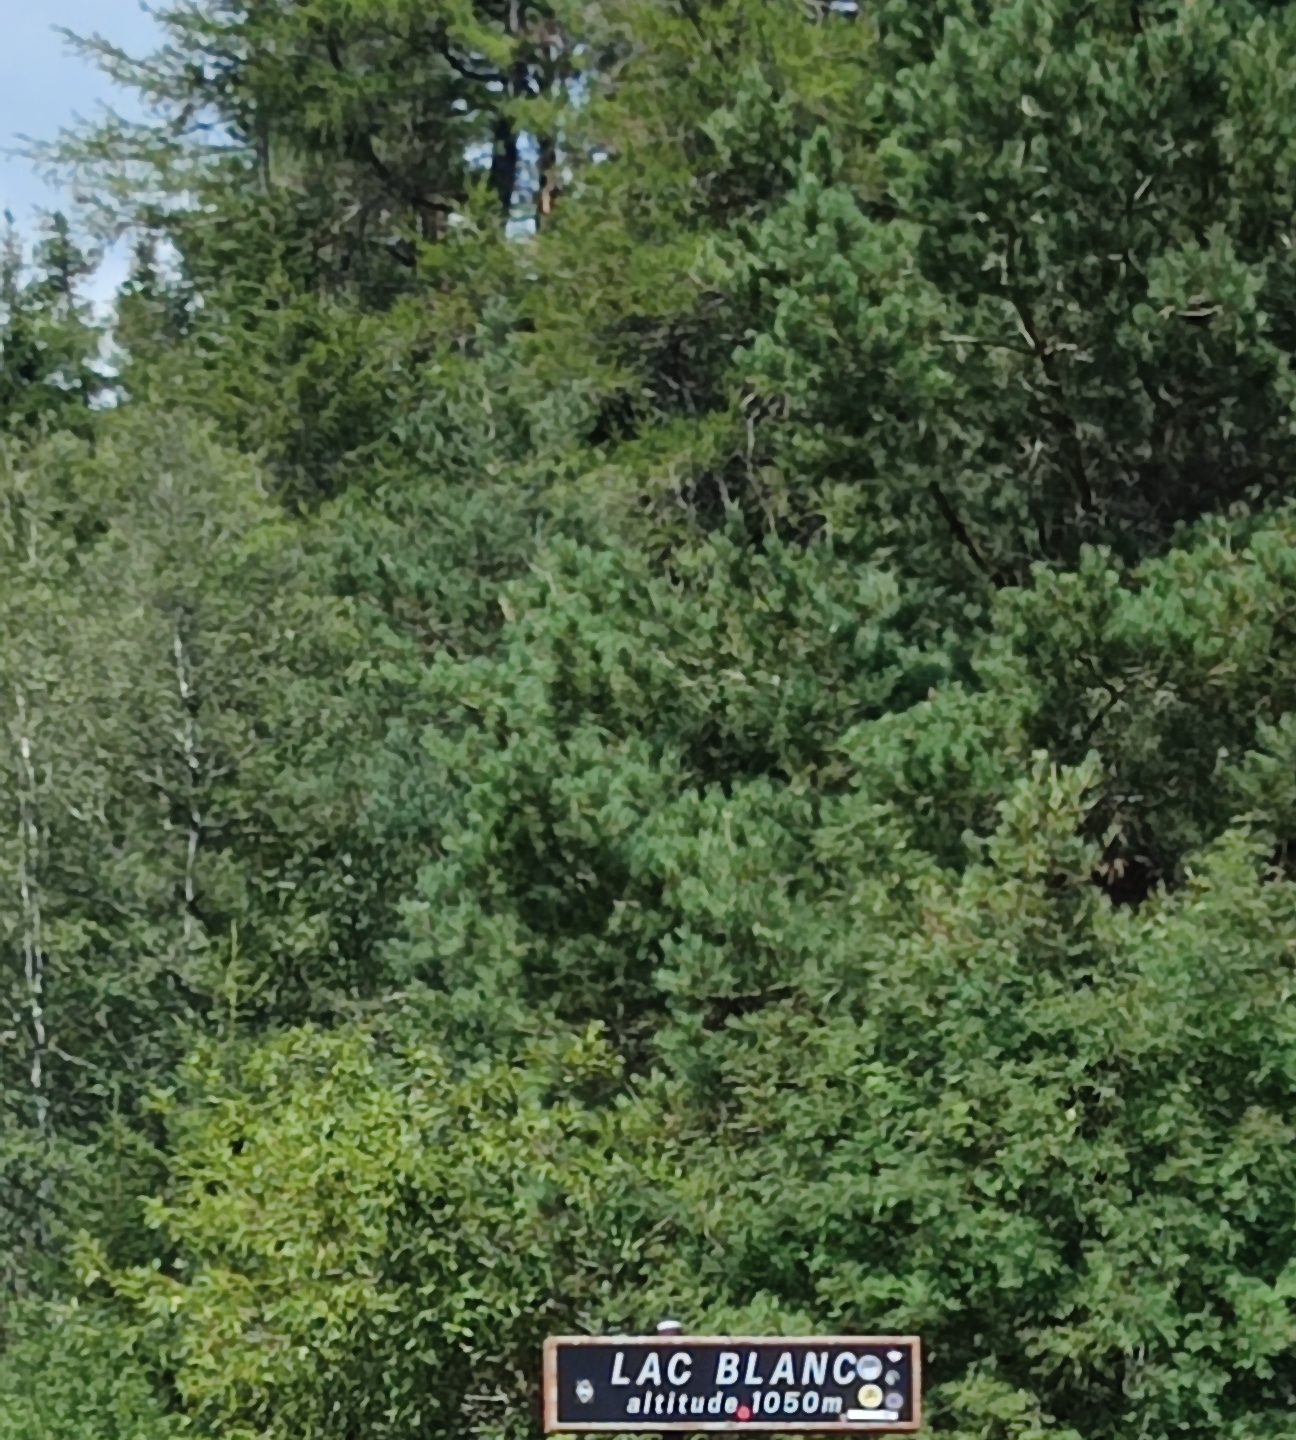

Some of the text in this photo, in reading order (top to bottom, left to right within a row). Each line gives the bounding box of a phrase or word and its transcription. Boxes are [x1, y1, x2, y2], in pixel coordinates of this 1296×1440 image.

[610, 1351, 858, 1387] LAC BLANC
[626, 1390, 844, 1415] altitude 1050m
